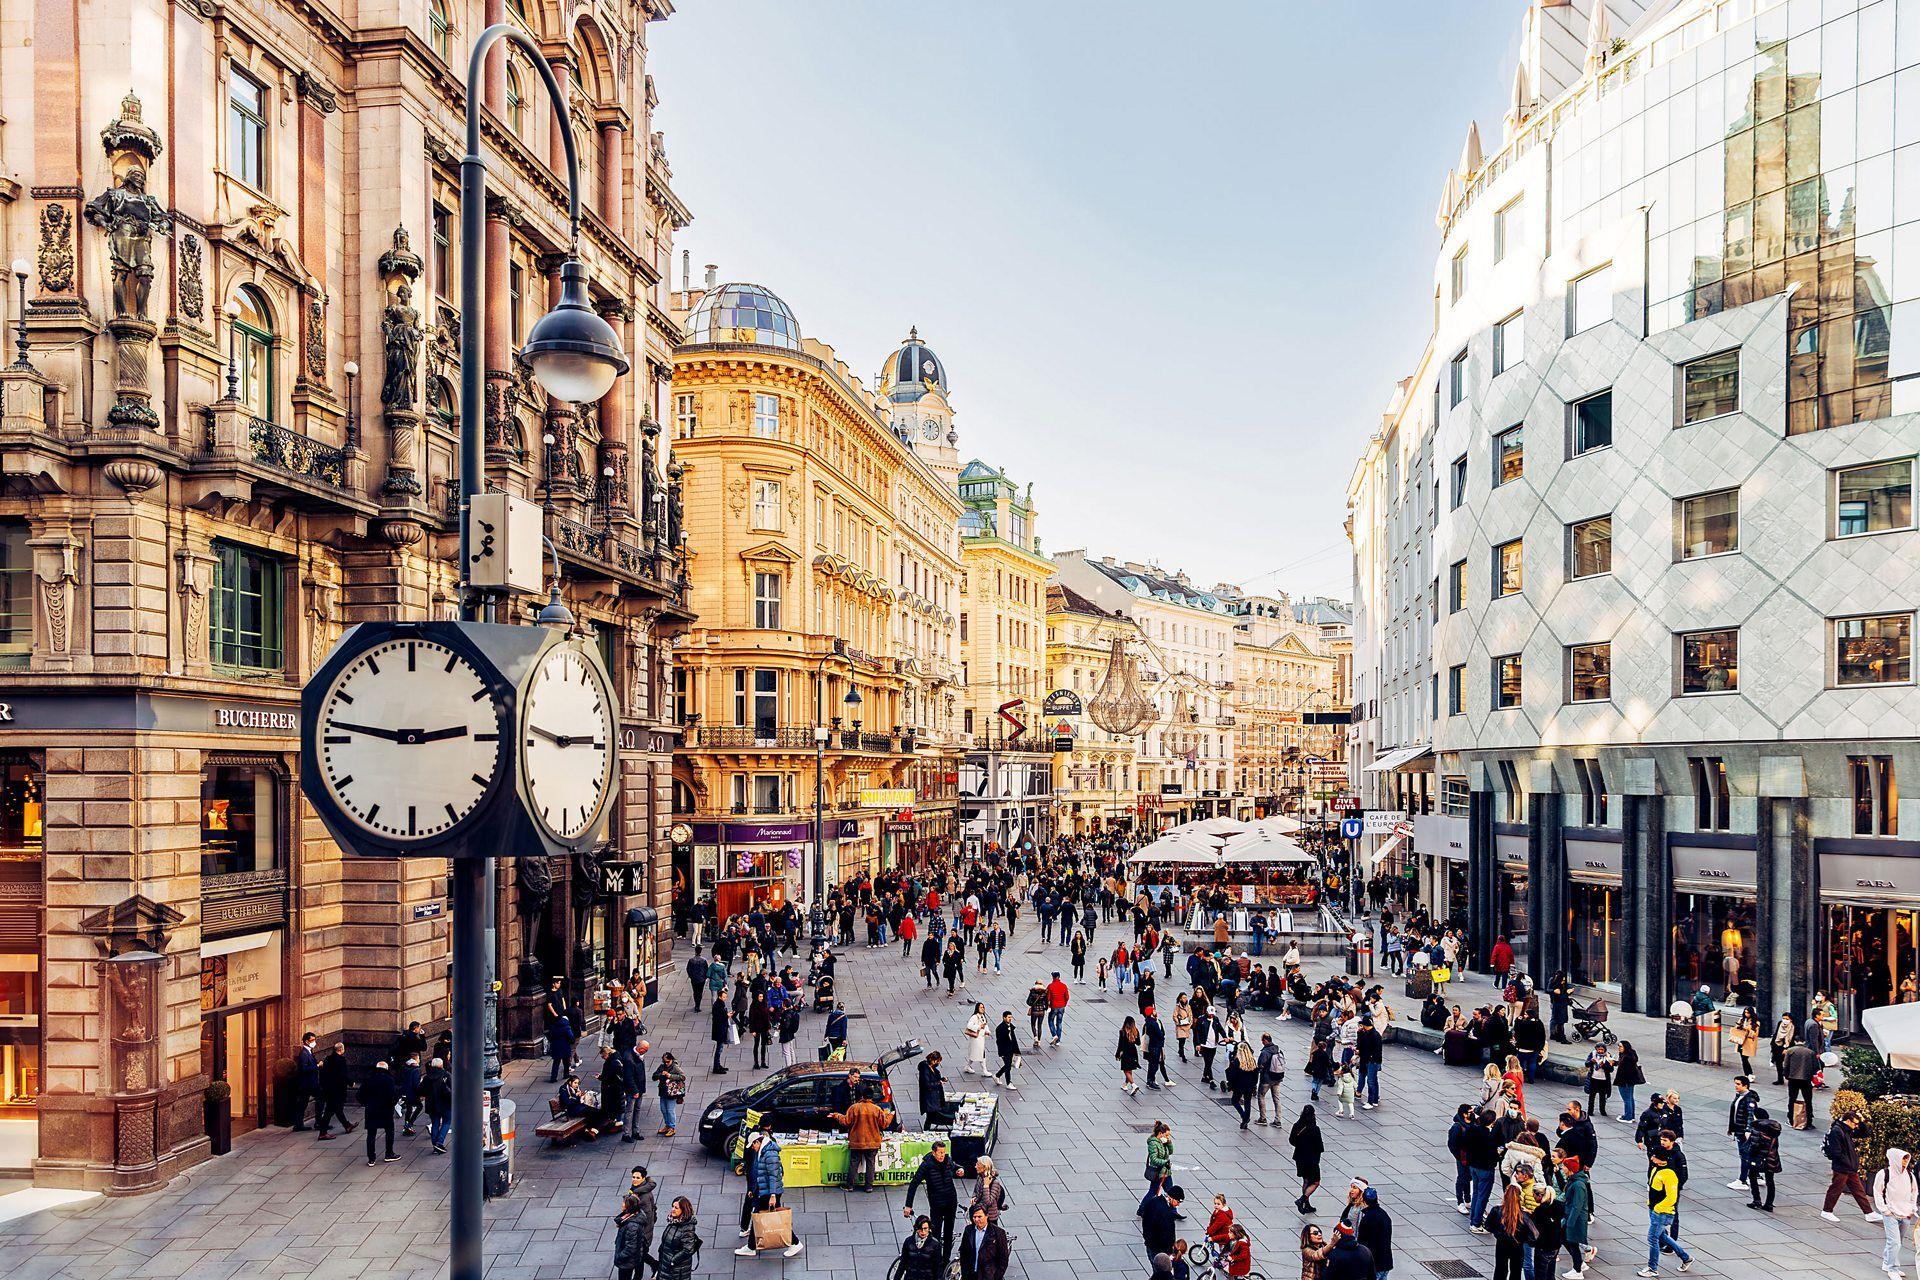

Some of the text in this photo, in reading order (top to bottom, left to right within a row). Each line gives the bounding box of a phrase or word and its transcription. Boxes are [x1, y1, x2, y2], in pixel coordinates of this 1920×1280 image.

[219, 709, 297, 729] BUCHERER
[756, 828, 792, 837] Marionnaud
[1585, 861, 1607, 869] ZARA
[1699, 869, 1730, 878] ZARA
[1856, 878, 1896, 888] ZARA
[221, 904, 268, 920] BUCHERER
